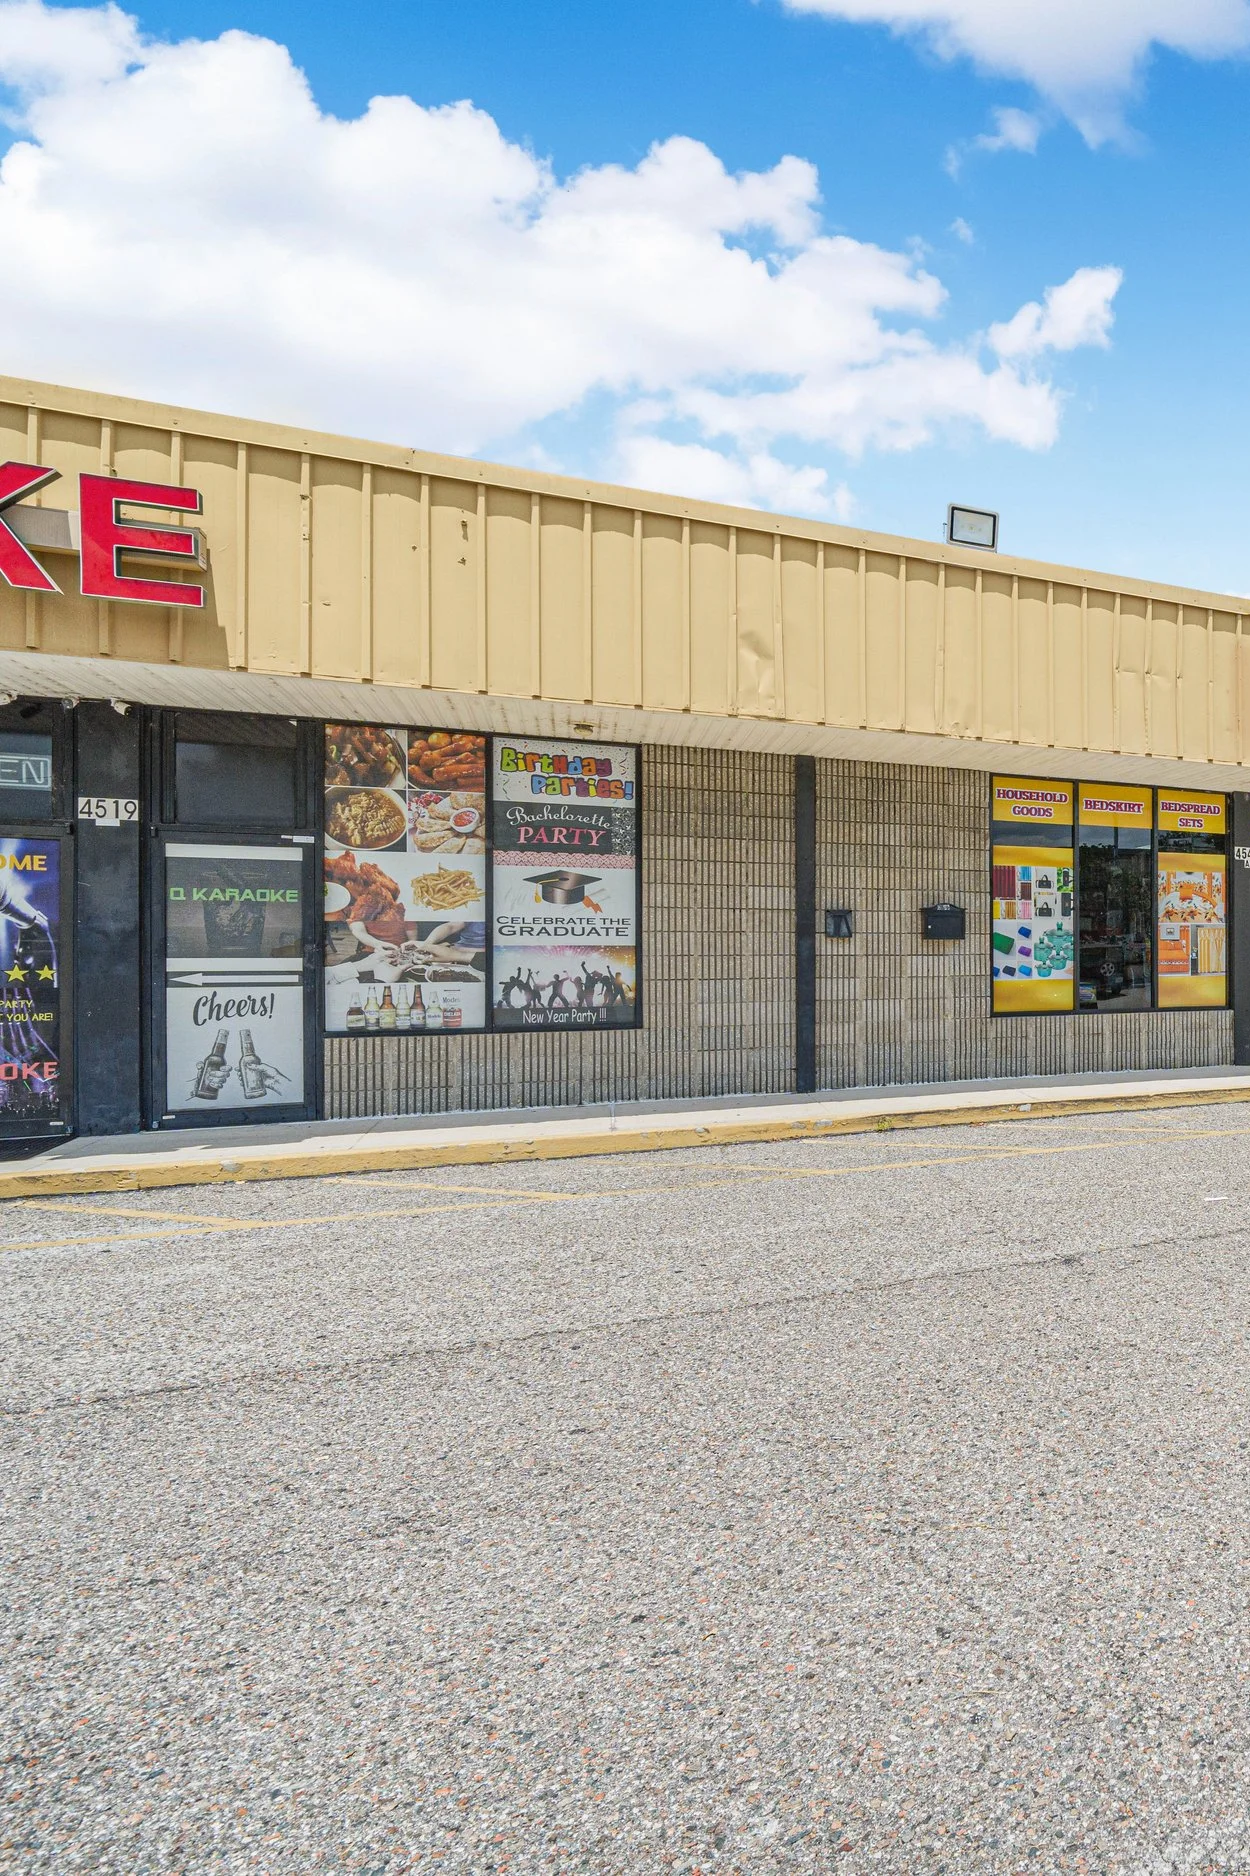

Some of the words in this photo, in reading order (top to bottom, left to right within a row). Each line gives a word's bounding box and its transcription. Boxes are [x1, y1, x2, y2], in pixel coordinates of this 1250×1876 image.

[996, 788, 1069, 803] HOUSEHOLD
[79, 799, 137, 820] 4519
[1012, 805, 1053, 818] GOODS
[1083, 799, 1144, 813] BEDSKIRT
[1160, 801, 1221, 815] BEDSPREAD
[506, 805, 614, 830] Bachelorette
[1178, 817, 1204, 828] SETS
[516, 826, 606, 847] PARTY
[1244, 859, 1250, 868] A
[169, 887, 186, 901] Q
[192, 887, 299, 903] KARAOKE
[496, 916, 596, 925] CELEBRATE
[599, 917, 632, 926] THE
[498, 925, 629, 937] GRADUATE
[193, 991, 275, 1027] Cheers!
[522, 1009, 544, 1024] New
[546, 1010, 569, 1023] Year
[571, 1008, 597, 1024] Party
[6, 1014, 29, 1022] YOU
[31, 1012, 54, 1021] ARE!
